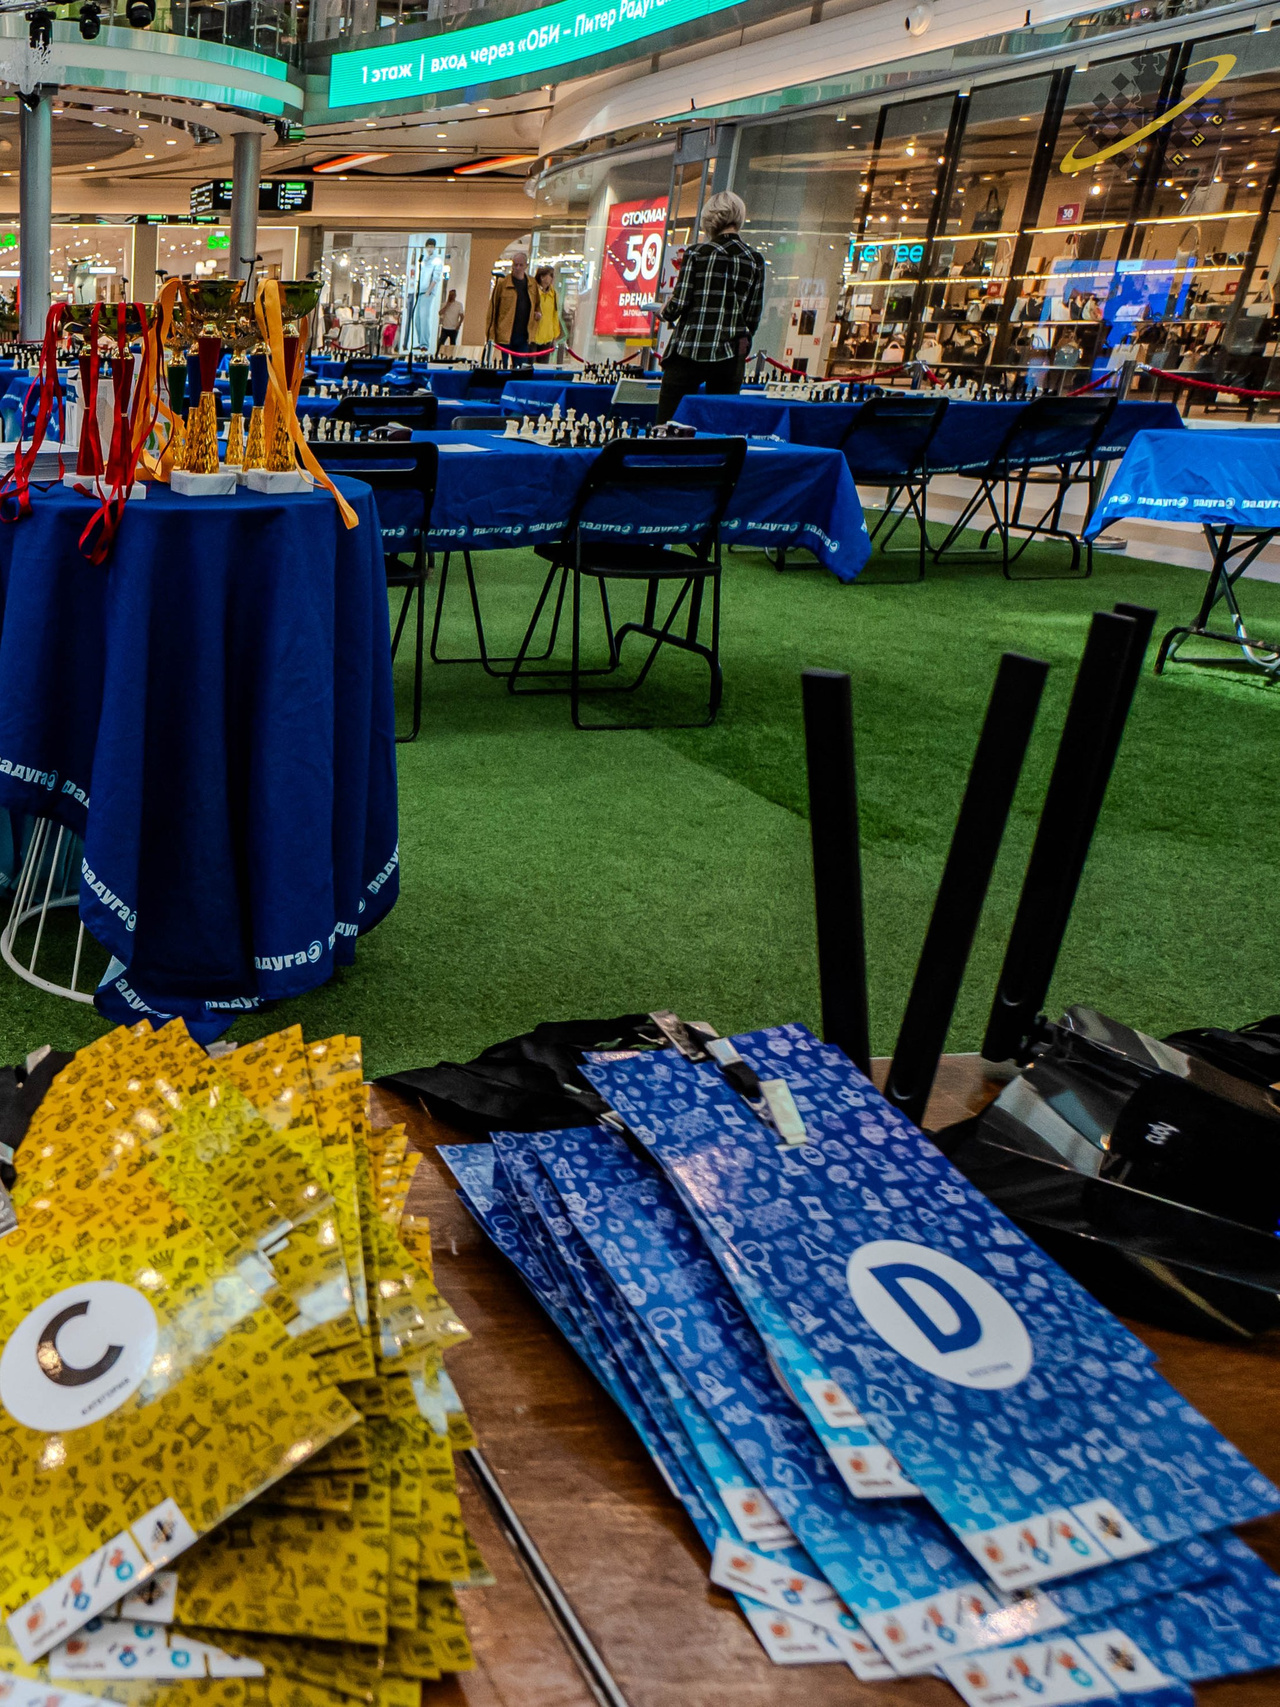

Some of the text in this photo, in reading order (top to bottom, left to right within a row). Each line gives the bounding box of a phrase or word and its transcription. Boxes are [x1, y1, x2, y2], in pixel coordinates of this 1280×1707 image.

[361, 65, 368, 84] 1
[371, 63, 412, 83] этаж
[430, 54, 468, 73] вход
[470, 42, 515, 65] через
[574, 8, 616, 37] Питер
[619, 0, 670, 22] Раду
[1137, 496, 1178, 507] радуга
[1193, 498, 1225, 508] радуга
[255, 951, 306, 971] адуга
[36, 1300, 125, 1387] C
[867, 1263, 983, 1355] D
